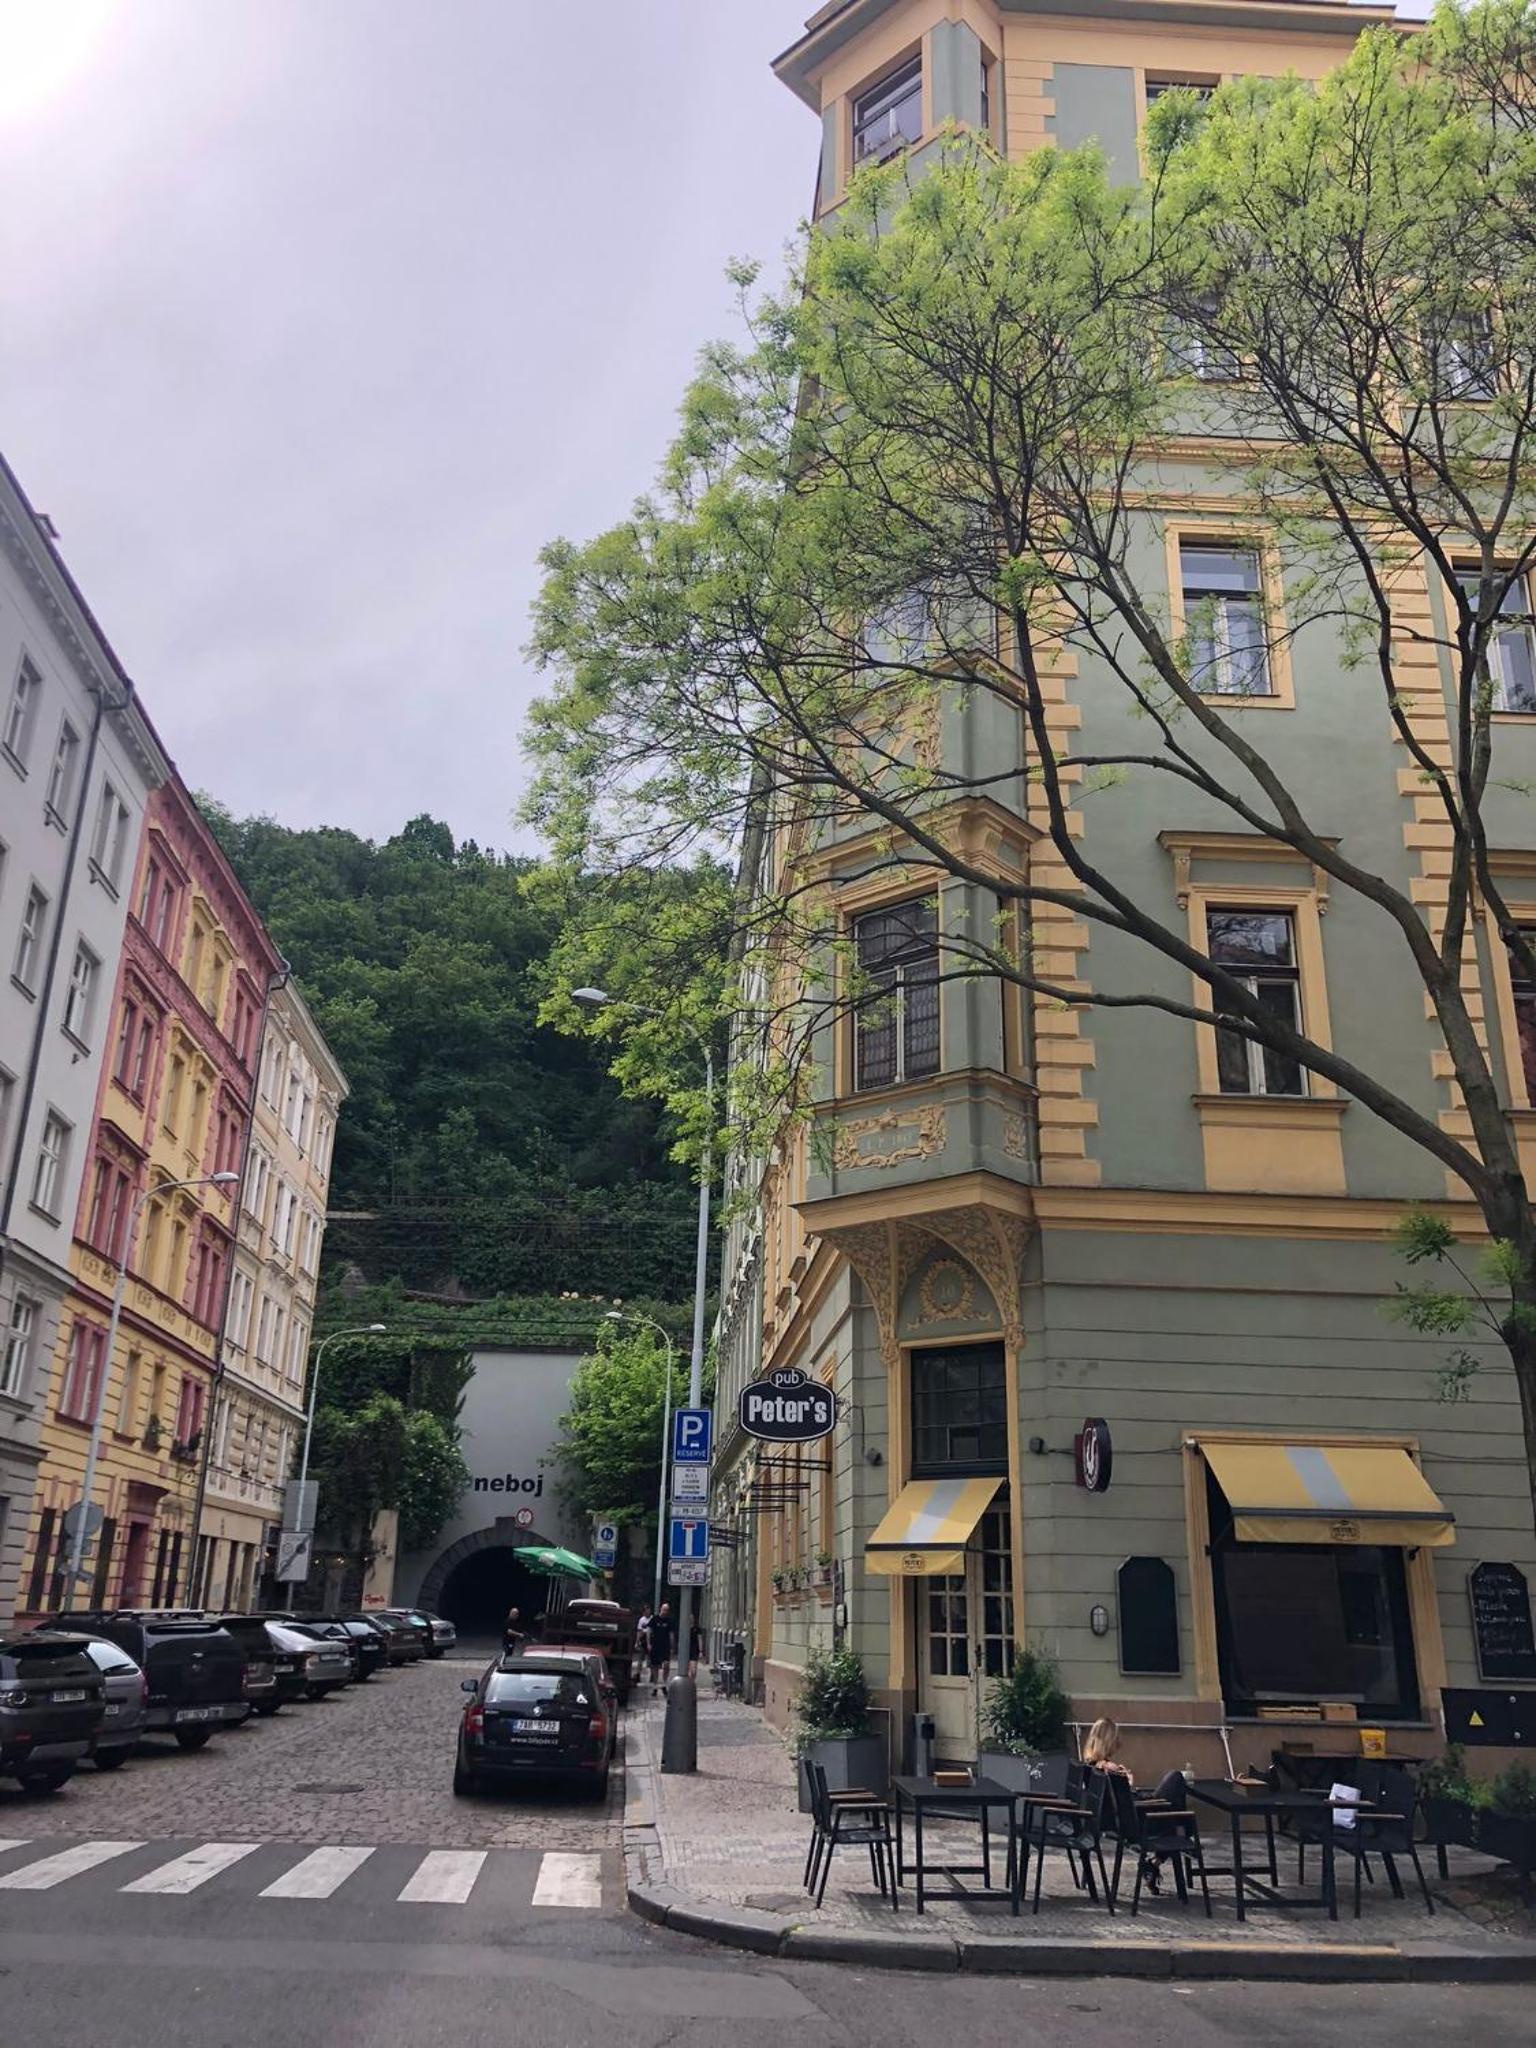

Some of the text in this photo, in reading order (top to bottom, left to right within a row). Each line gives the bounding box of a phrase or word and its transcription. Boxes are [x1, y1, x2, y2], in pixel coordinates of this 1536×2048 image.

[775, 1369, 799, 1387] pub
[749, 1395, 827, 1423] Peter's
[682, 1415, 703, 1446] P
[474, 1474, 543, 1497] neboj
